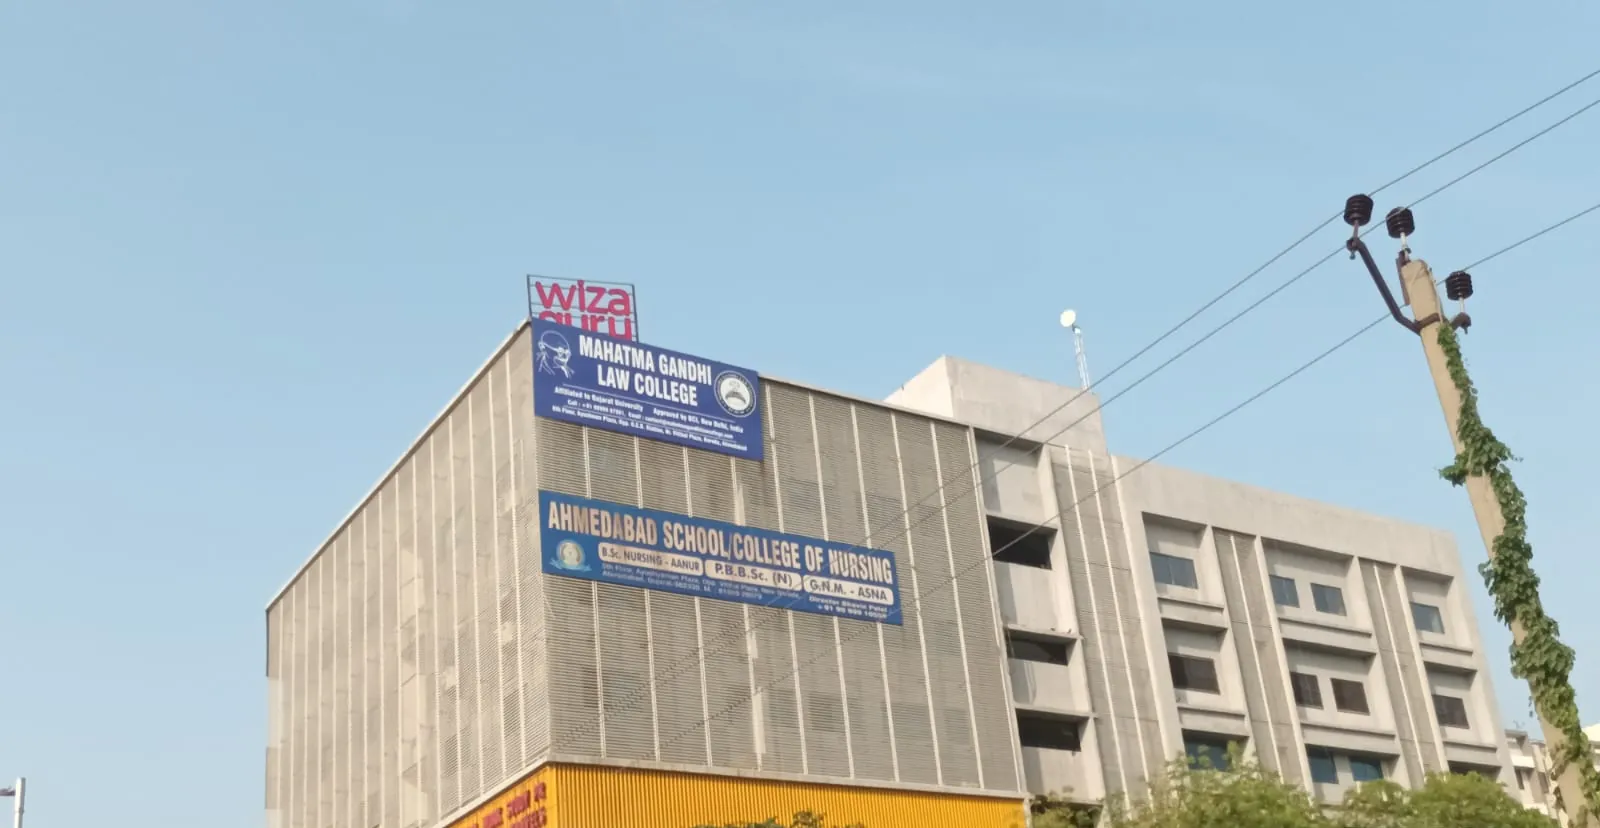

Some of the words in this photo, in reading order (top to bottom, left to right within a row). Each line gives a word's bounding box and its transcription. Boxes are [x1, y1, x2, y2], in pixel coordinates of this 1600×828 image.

[535, 279, 631, 316] wiza
[579, 334, 655, 373] MAHATMA
[659, 353, 712, 386] GANDHI
[597, 364, 630, 392] LAW
[634, 373, 697, 406] COLLEGE
[548, 501, 658, 546] AHMEDABAD
[663, 520, 801, 569] SCHOOL/COLLEGE
[805, 544, 824, 572] OF
[828, 549, 893, 585] NURSING
[602, 546, 621, 559] B.Sc.
[623, 550, 662, 566] NURSING
[671, 558, 700, 570] AANUR
[715, 563, 768, 581] P.B.B.Sc.
[772, 572, 793, 587] (N)
[809, 579, 847, 595] G.N.M.
[858, 587, 887, 601] ASNA
